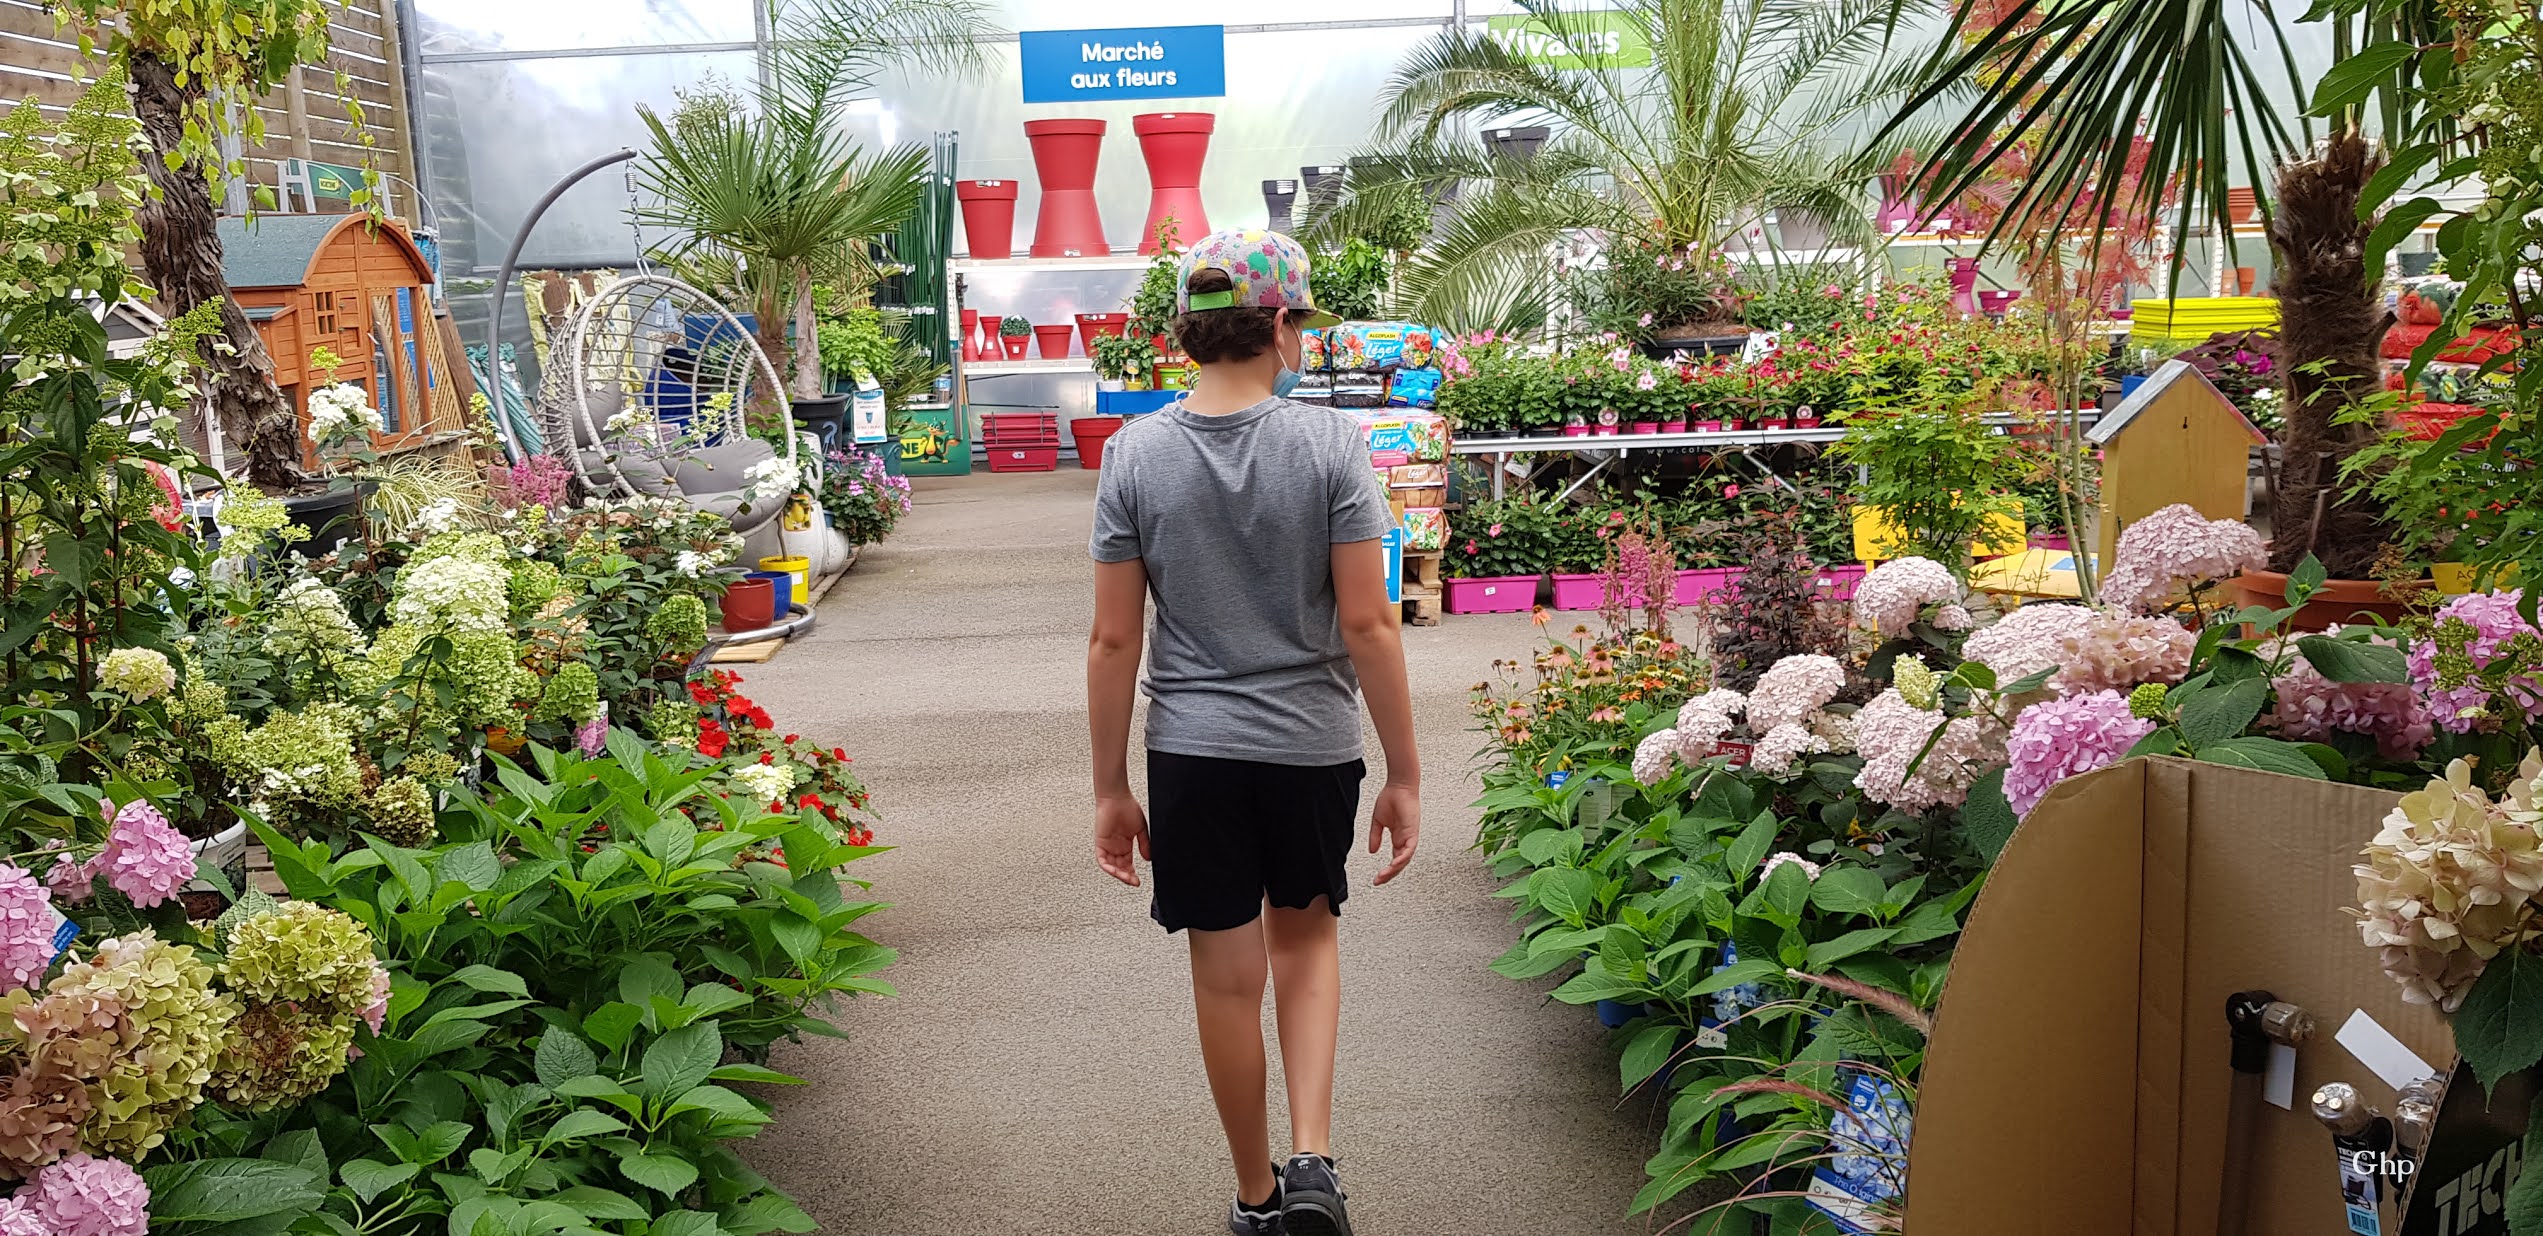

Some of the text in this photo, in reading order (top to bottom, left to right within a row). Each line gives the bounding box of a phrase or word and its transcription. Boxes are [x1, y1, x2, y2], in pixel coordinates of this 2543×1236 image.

[1081, 41, 1164, 62] Marché
[1070, 68, 1177, 89] aux fleurs
[1366, 342, 1400, 359] Léger
[1373, 434, 1403, 448] Léger
[1720, 746, 1746, 757] ACER
